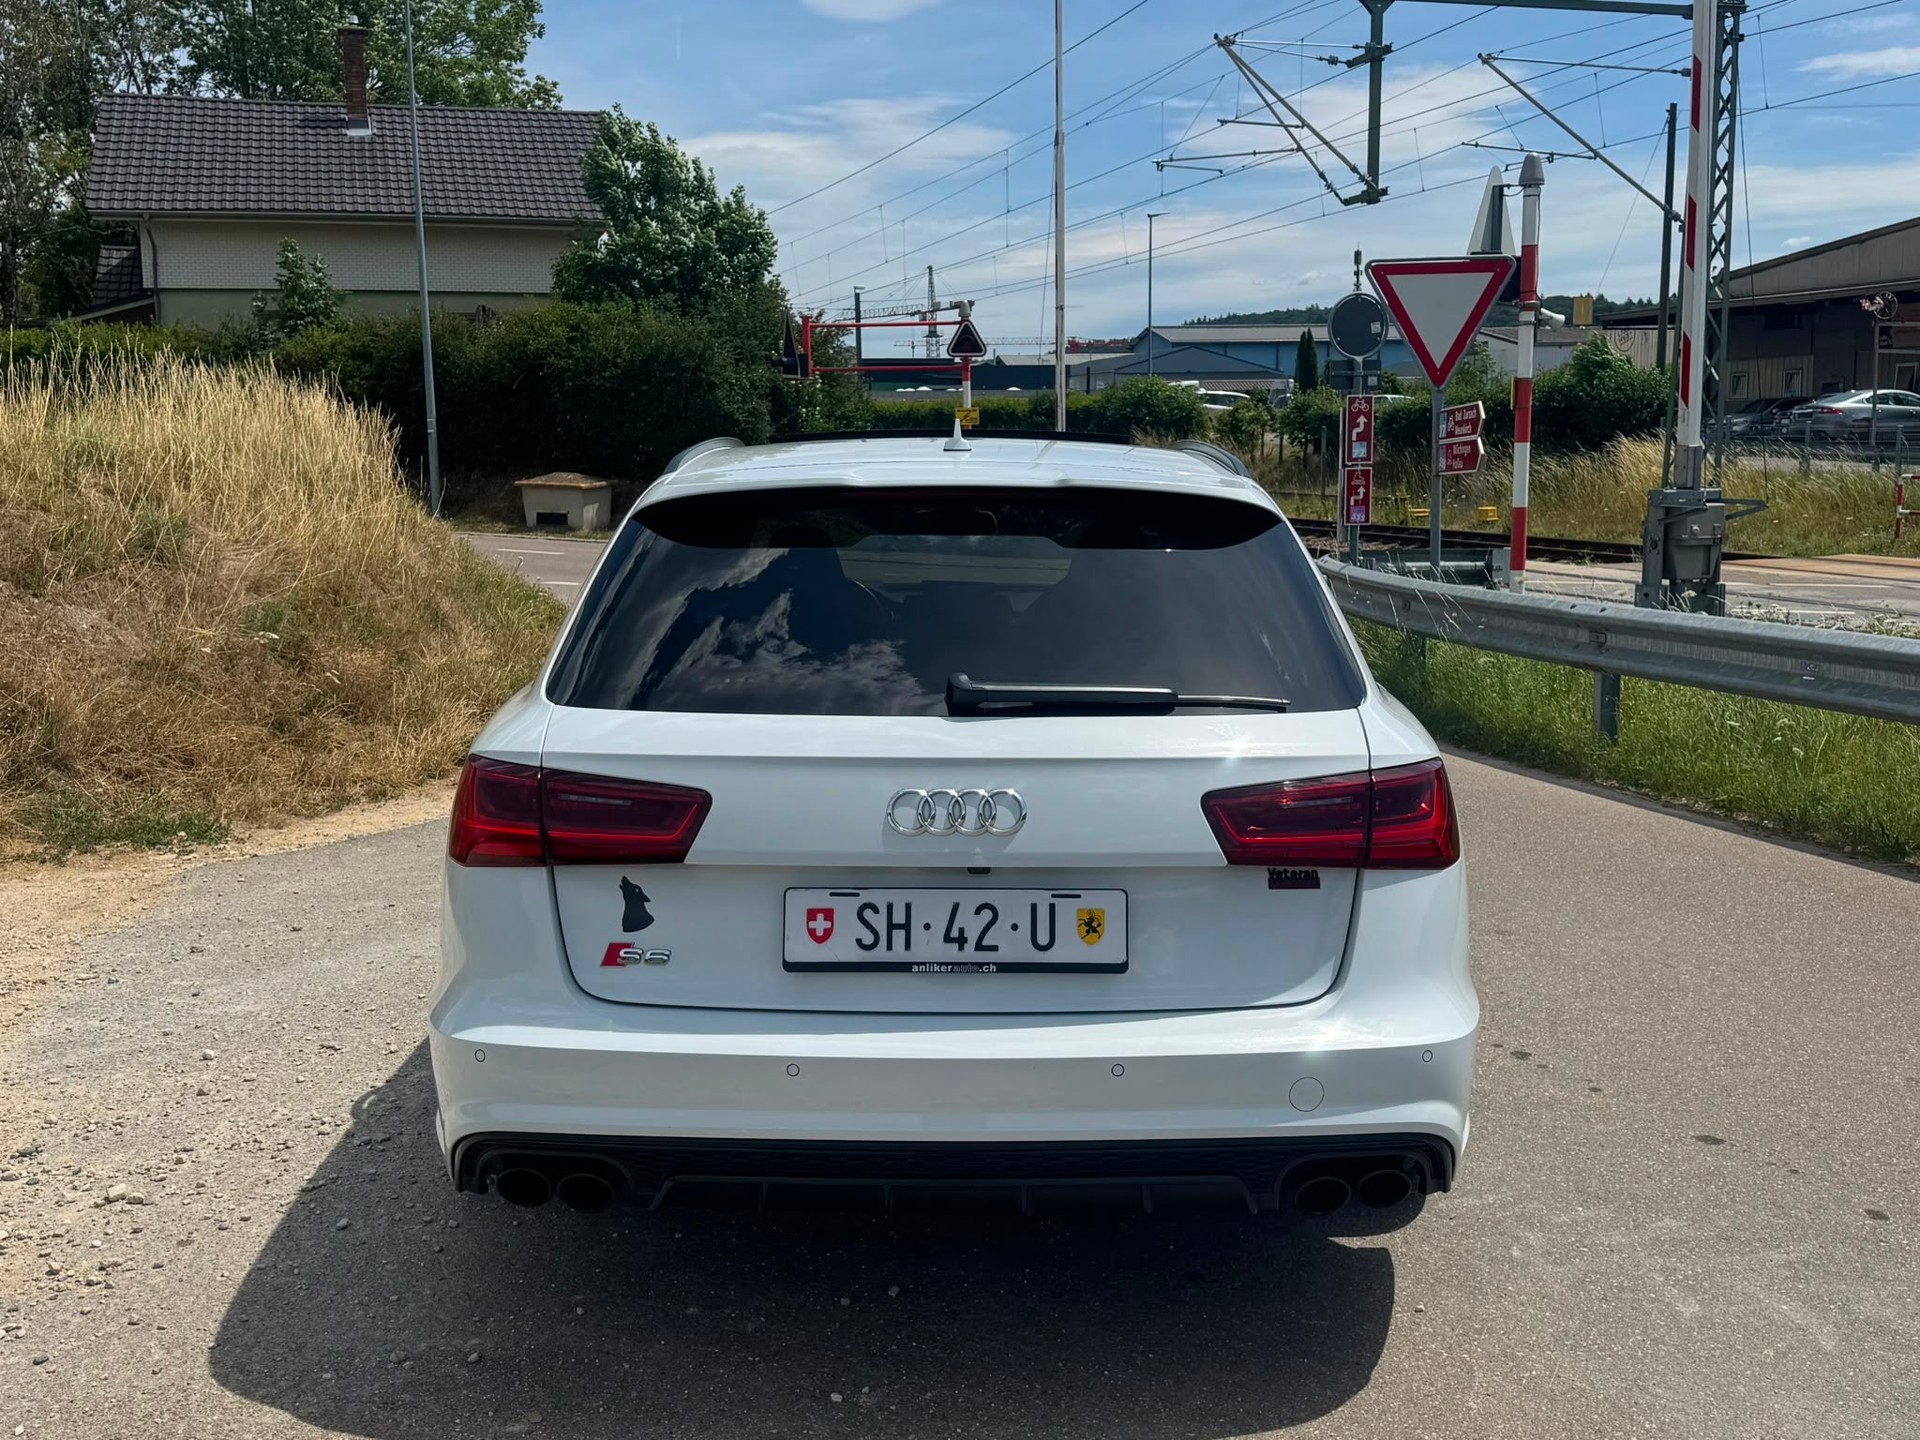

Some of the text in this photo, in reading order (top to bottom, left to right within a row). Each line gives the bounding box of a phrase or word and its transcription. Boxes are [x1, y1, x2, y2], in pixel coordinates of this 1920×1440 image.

[1267, 867, 1319, 879] Veteran
[617, 948, 672, 965] S6
[911, 963, 997, 973] anlikerauto.ch
